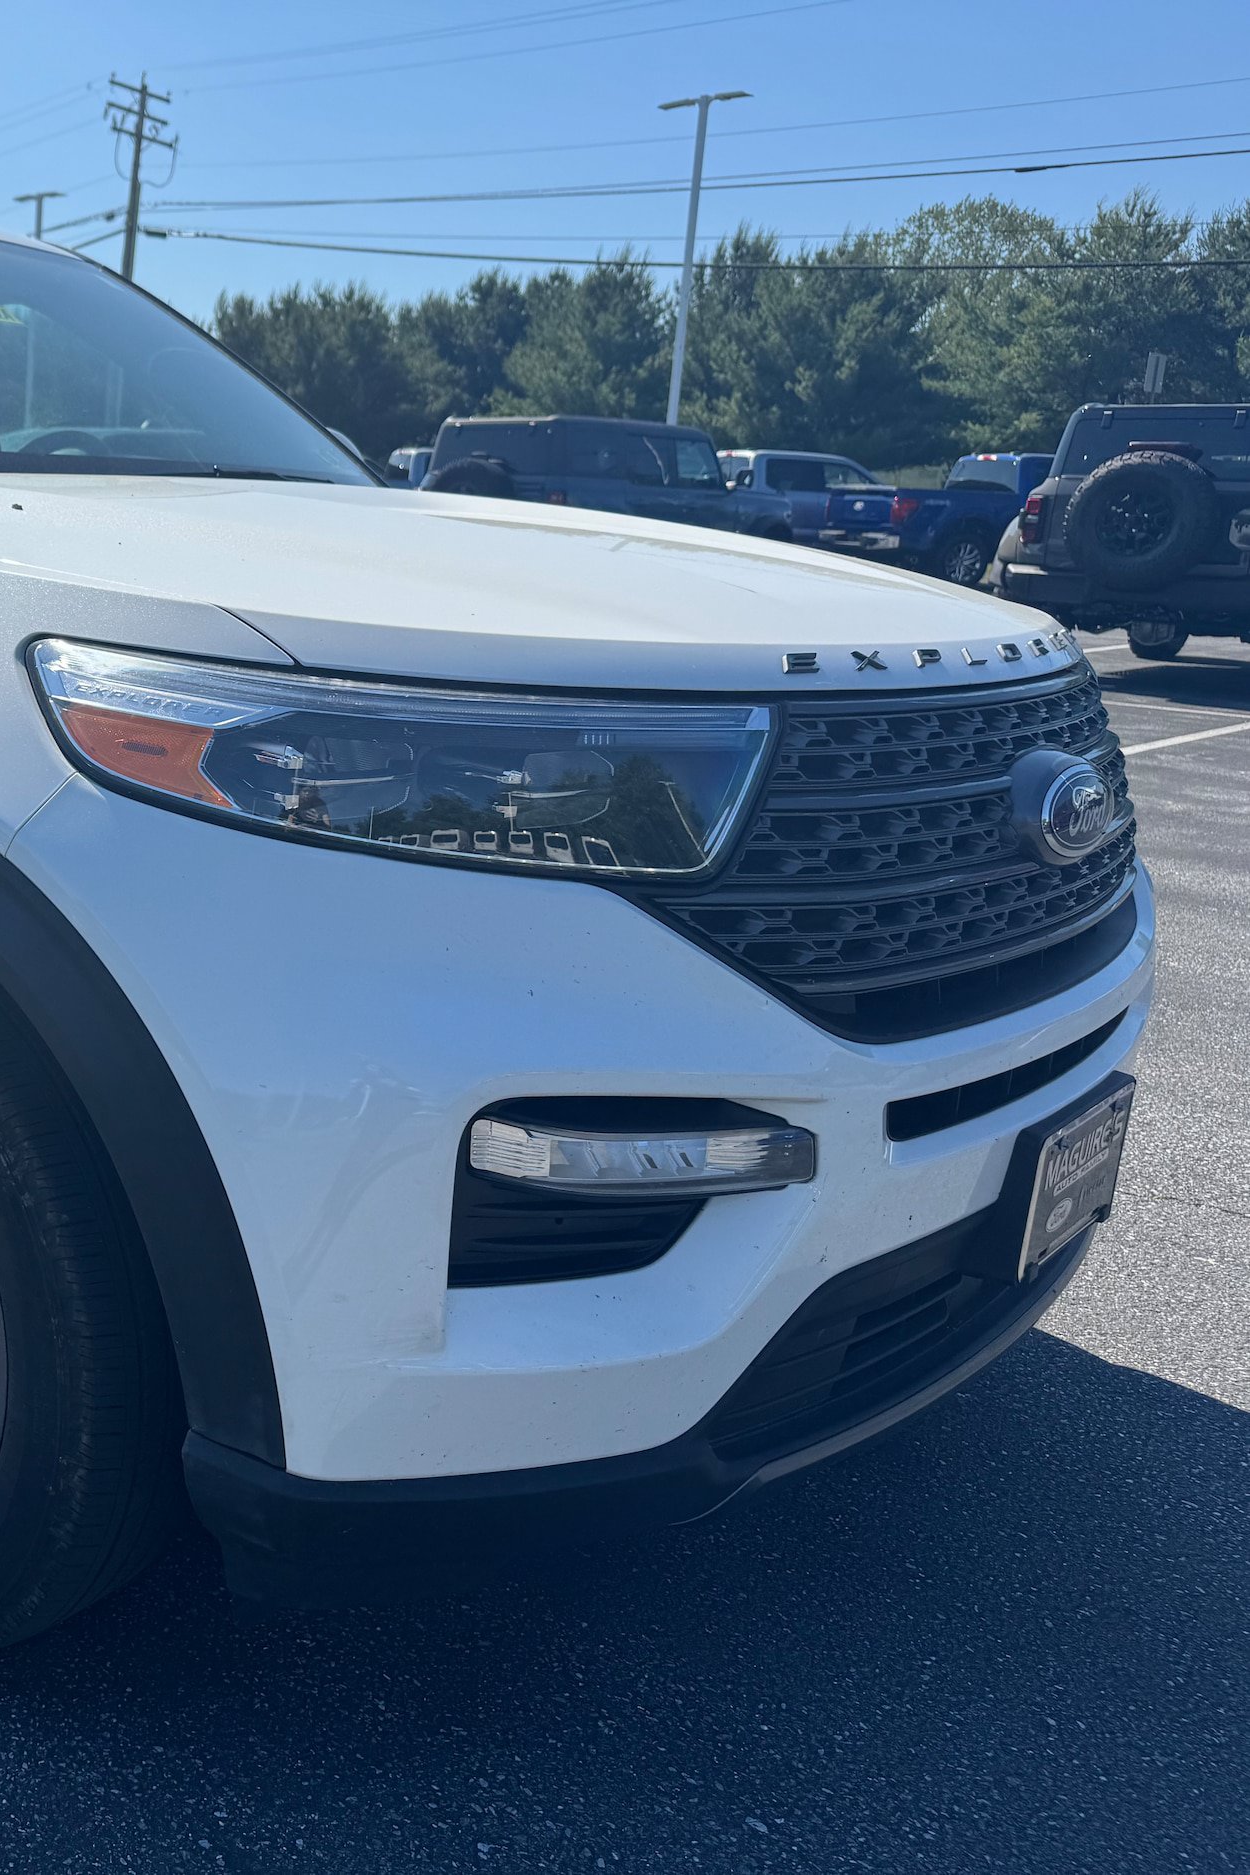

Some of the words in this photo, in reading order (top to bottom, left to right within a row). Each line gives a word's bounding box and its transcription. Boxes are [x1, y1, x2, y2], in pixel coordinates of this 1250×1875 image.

[782, 628, 1073, 675] EXPLORE
[73, 682, 226, 718] EXPLORER
[1068, 784, 1106, 838] Ford
[1045, 1110, 1126, 1191] MAGUIRE'S
[1055, 1172, 1078, 1192] AUTO
